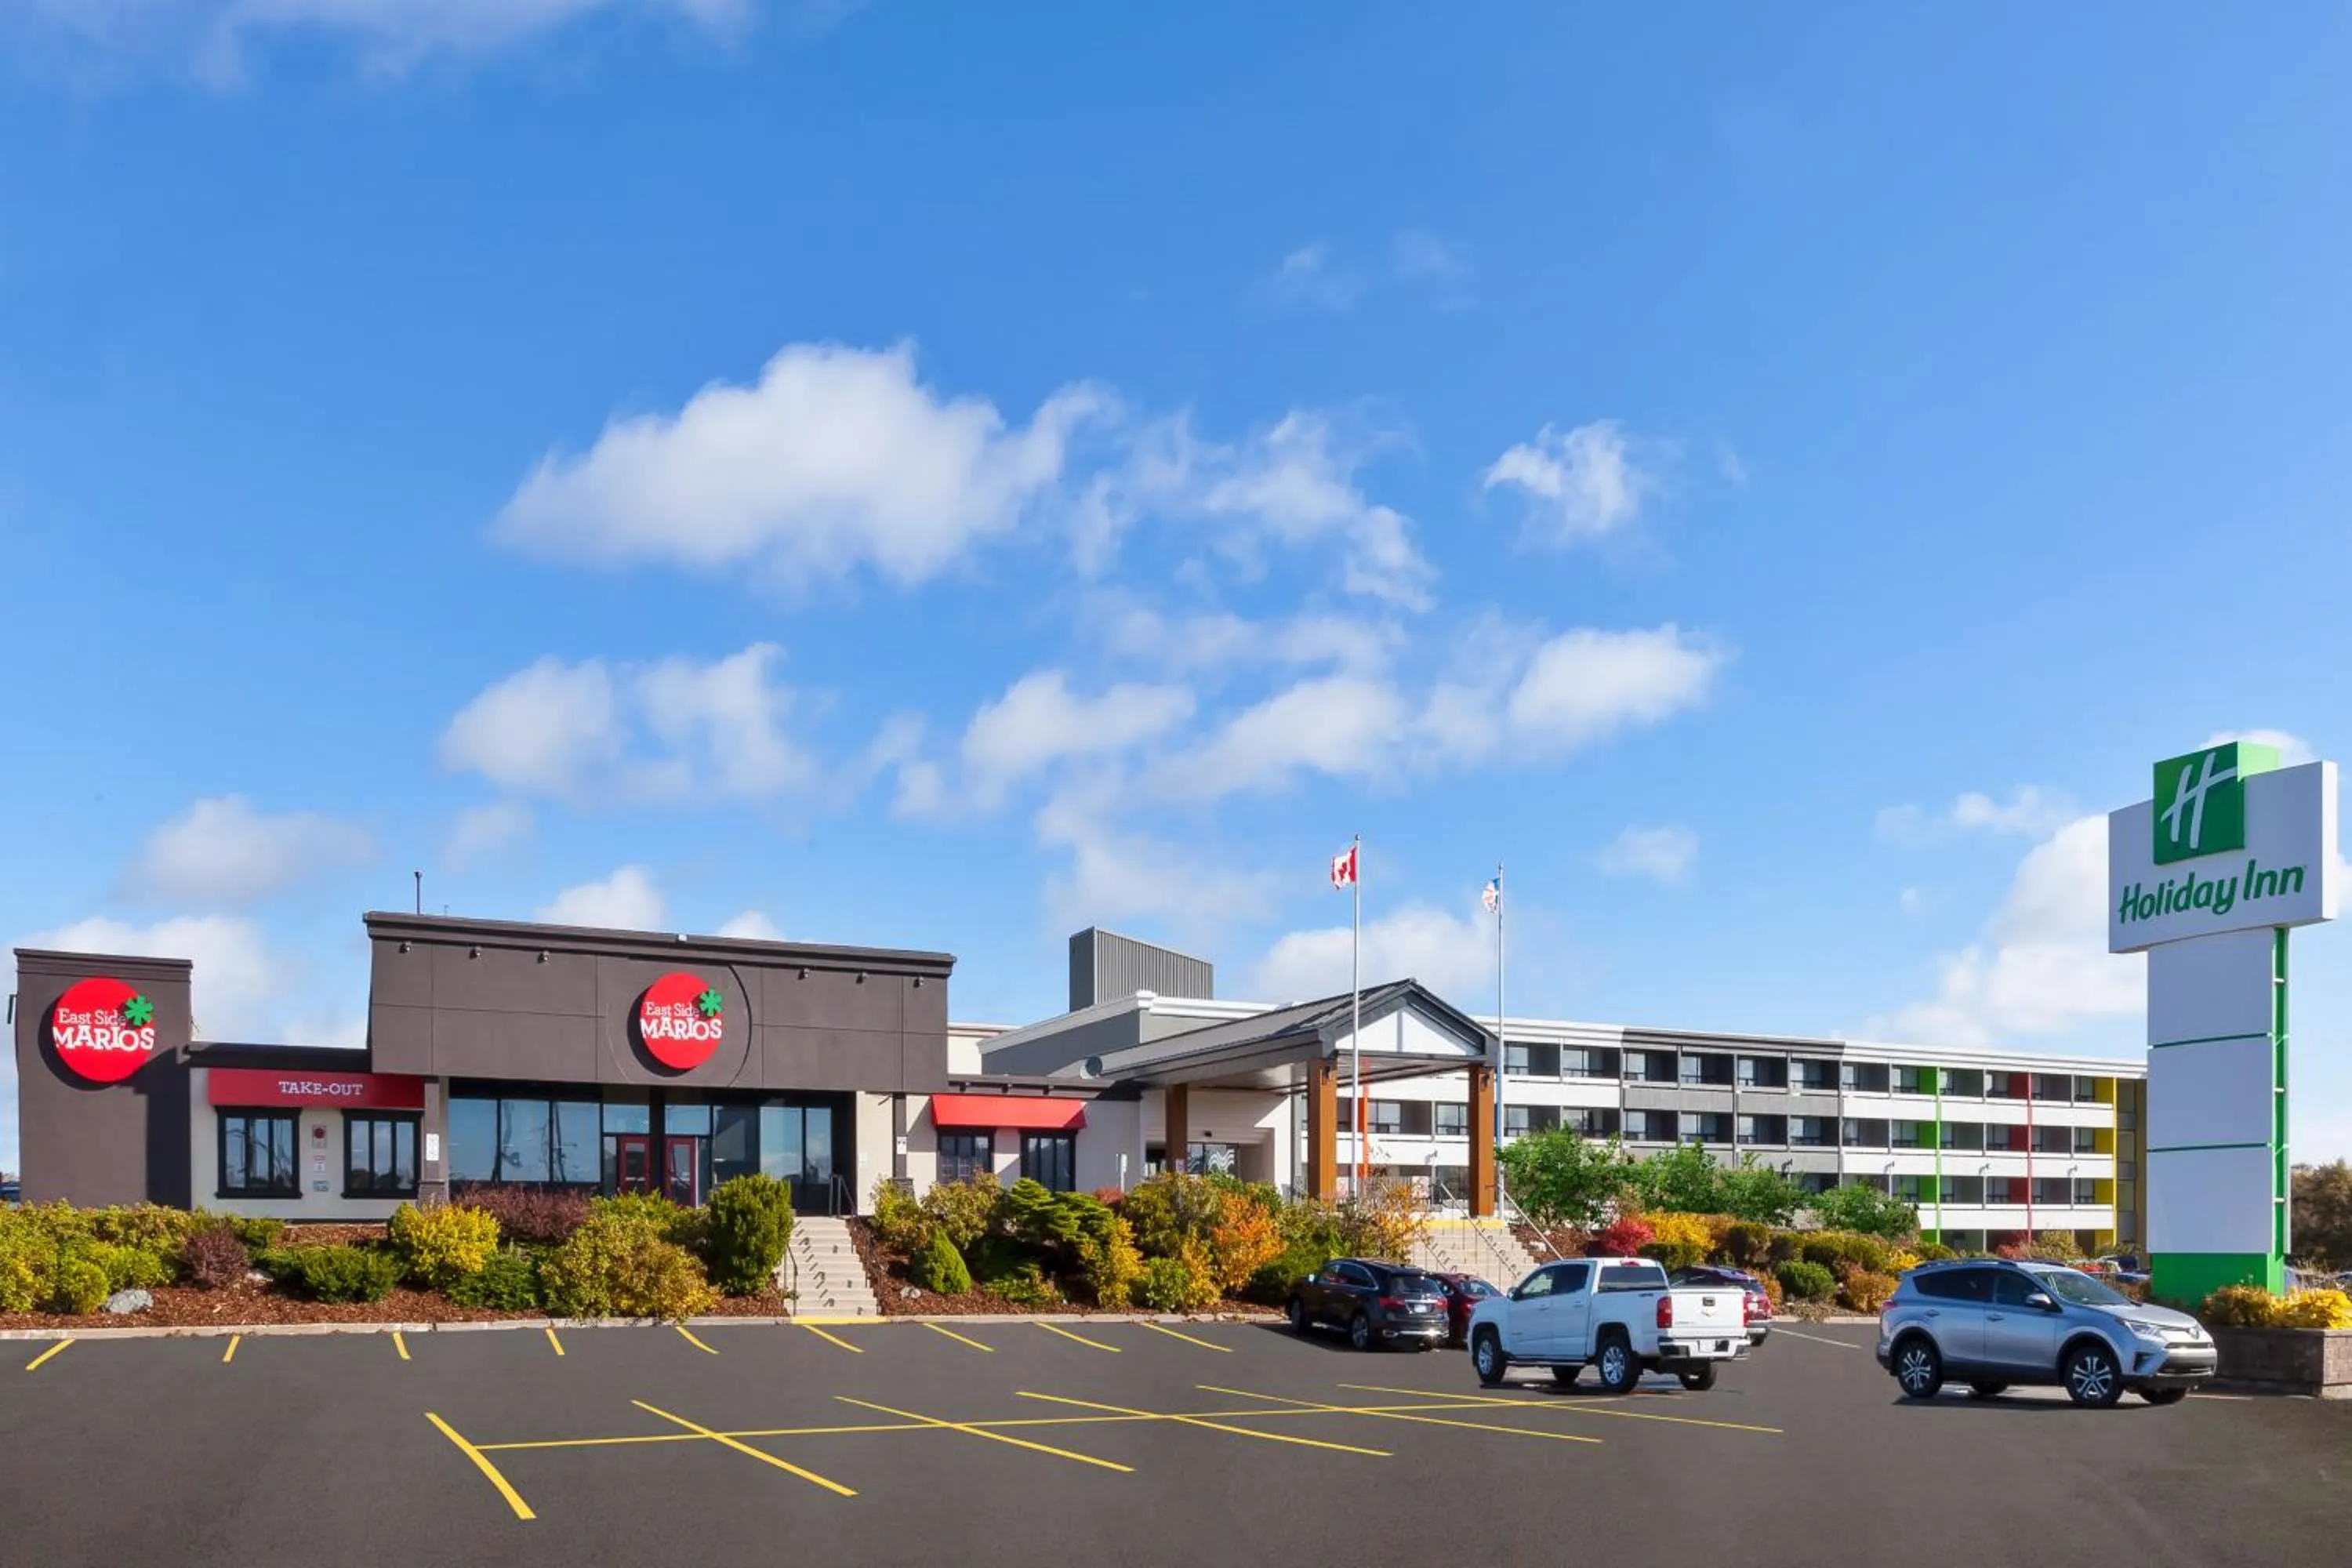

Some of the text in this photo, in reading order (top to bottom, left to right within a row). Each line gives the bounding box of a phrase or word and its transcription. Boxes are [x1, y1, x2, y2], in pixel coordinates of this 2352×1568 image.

[2118, 858, 2304, 924] Holiday Inn
[57, 1007, 126, 1026] East Side
[645, 1001, 699, 1018] East Side
[53, 1024, 154, 1051] MARIOS
[640, 1015, 722, 1040] MARIOS
[278, 1081, 363, 1095] TAKE-OUT
